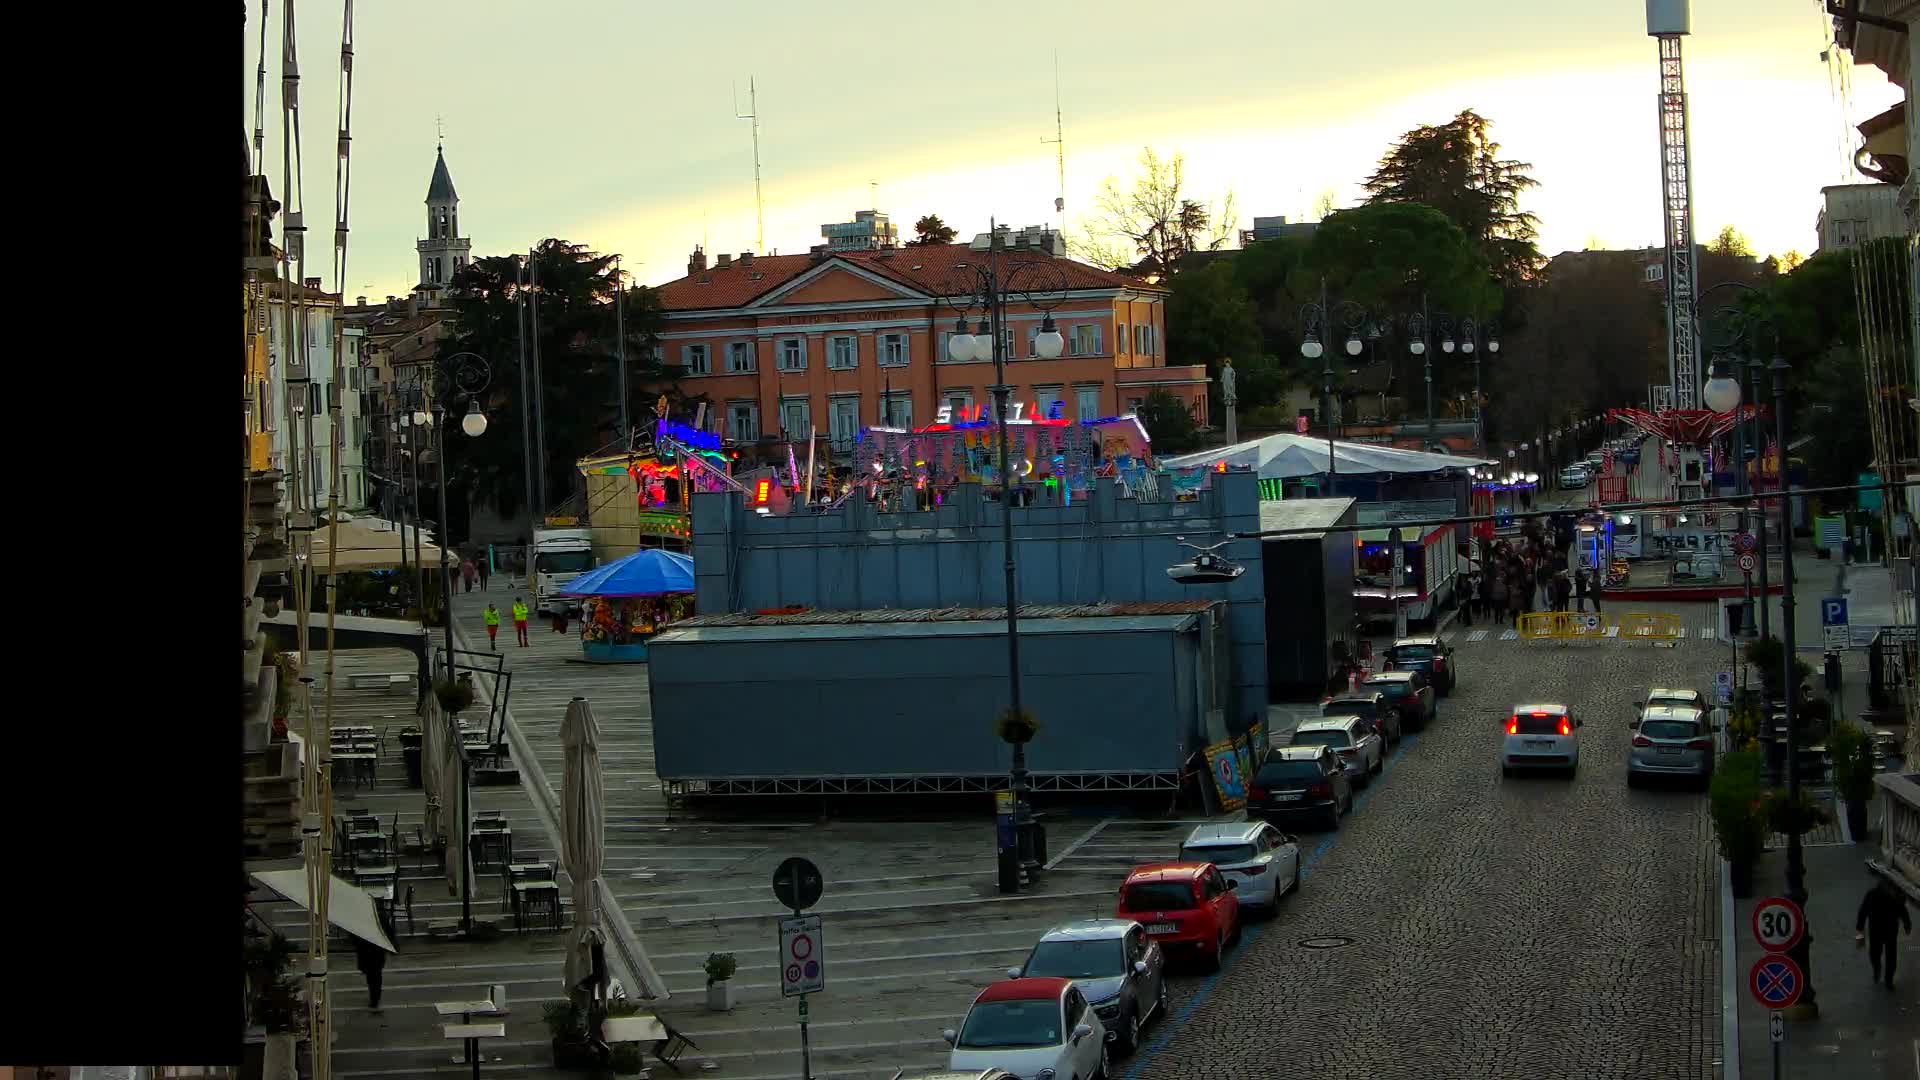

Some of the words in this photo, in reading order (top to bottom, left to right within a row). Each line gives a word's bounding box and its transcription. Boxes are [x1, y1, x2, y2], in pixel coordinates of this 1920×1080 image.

[1742, 557, 1753, 567] 20
[1827, 602, 1842, 622] P
[1761, 912, 1791, 937] 30
